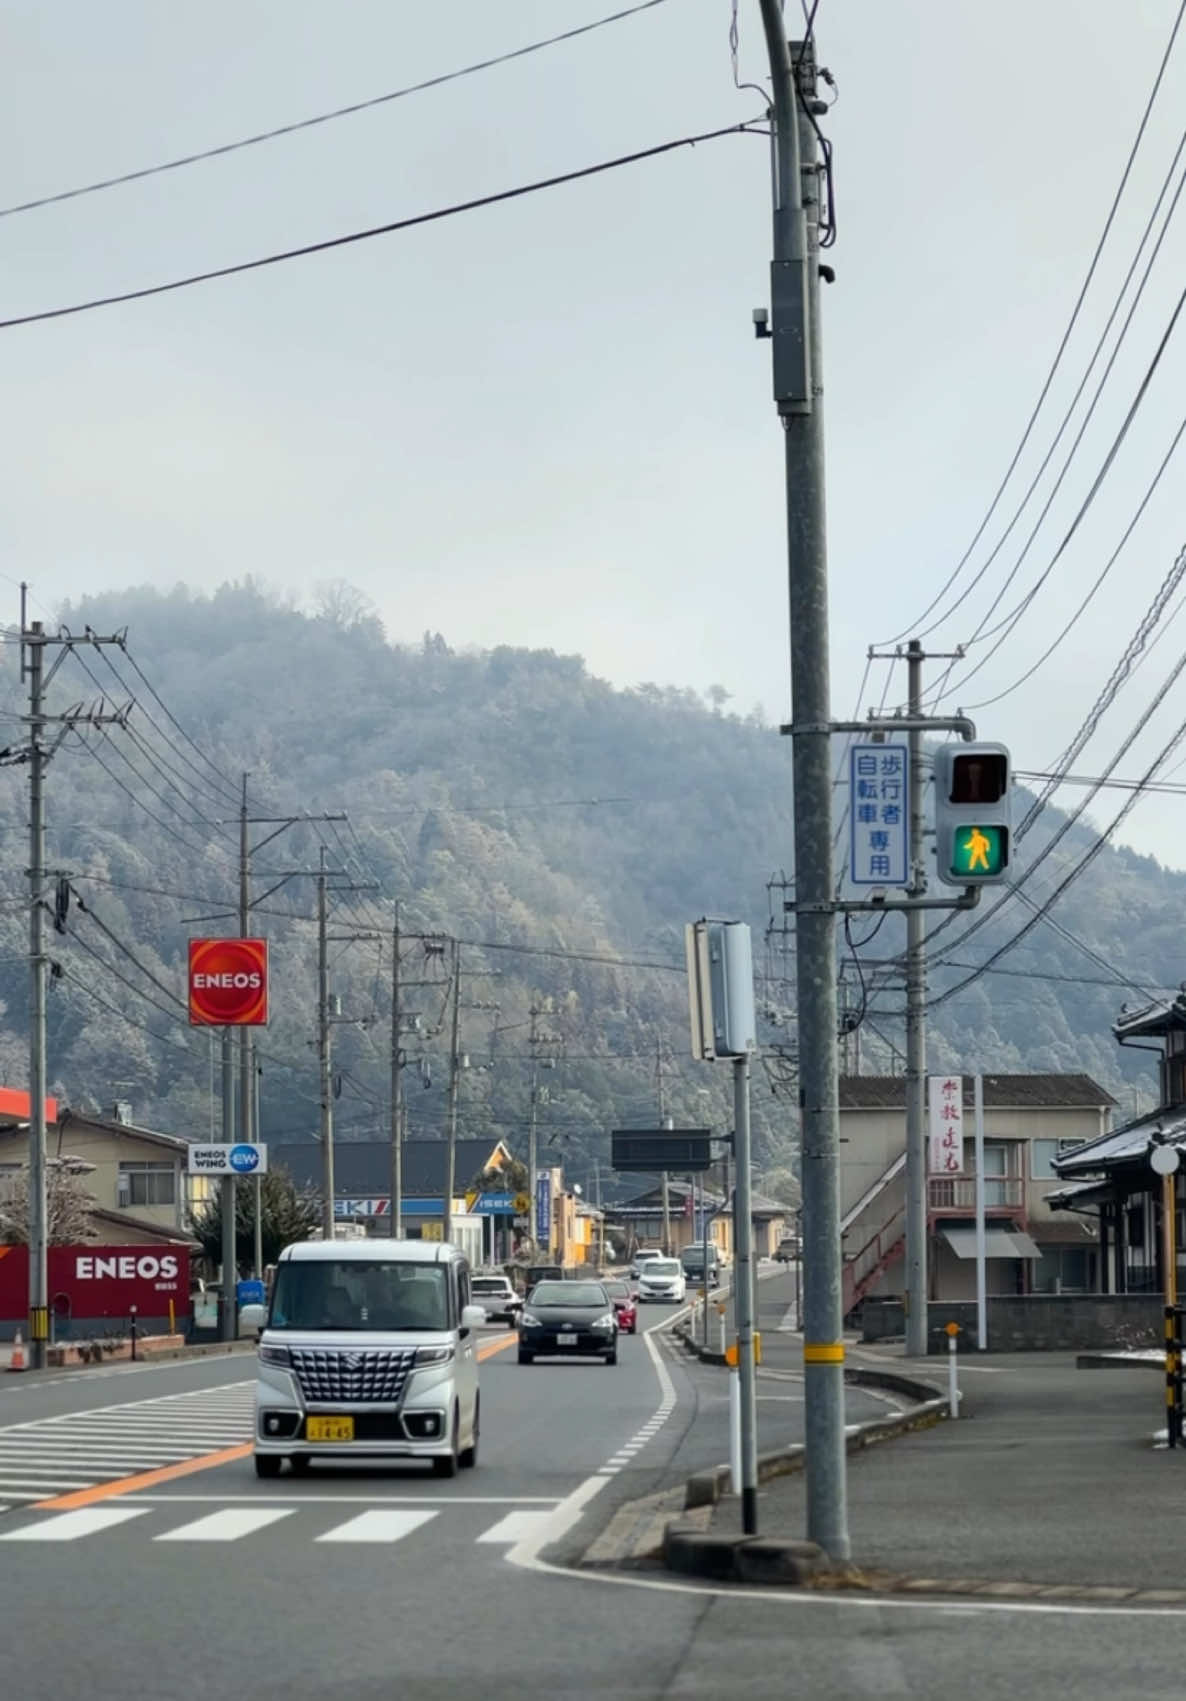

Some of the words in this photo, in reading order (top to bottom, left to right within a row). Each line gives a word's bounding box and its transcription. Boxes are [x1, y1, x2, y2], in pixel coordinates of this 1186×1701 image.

[856, 755, 878, 824] 自転車
[881, 755, 902, 824] 歩行者
[869, 830, 890, 876] 専用
[193, 972, 262, 990] ENEOS
[194, 1150, 227, 1159] ENEOS
[233, 1153, 257, 1166] EW
[195, 1159, 227, 1168] WING
[334, 1200, 372, 1214] EKI
[480, 1199, 512, 1212] ISEK
[76, 1256, 178, 1279] ENEOS
